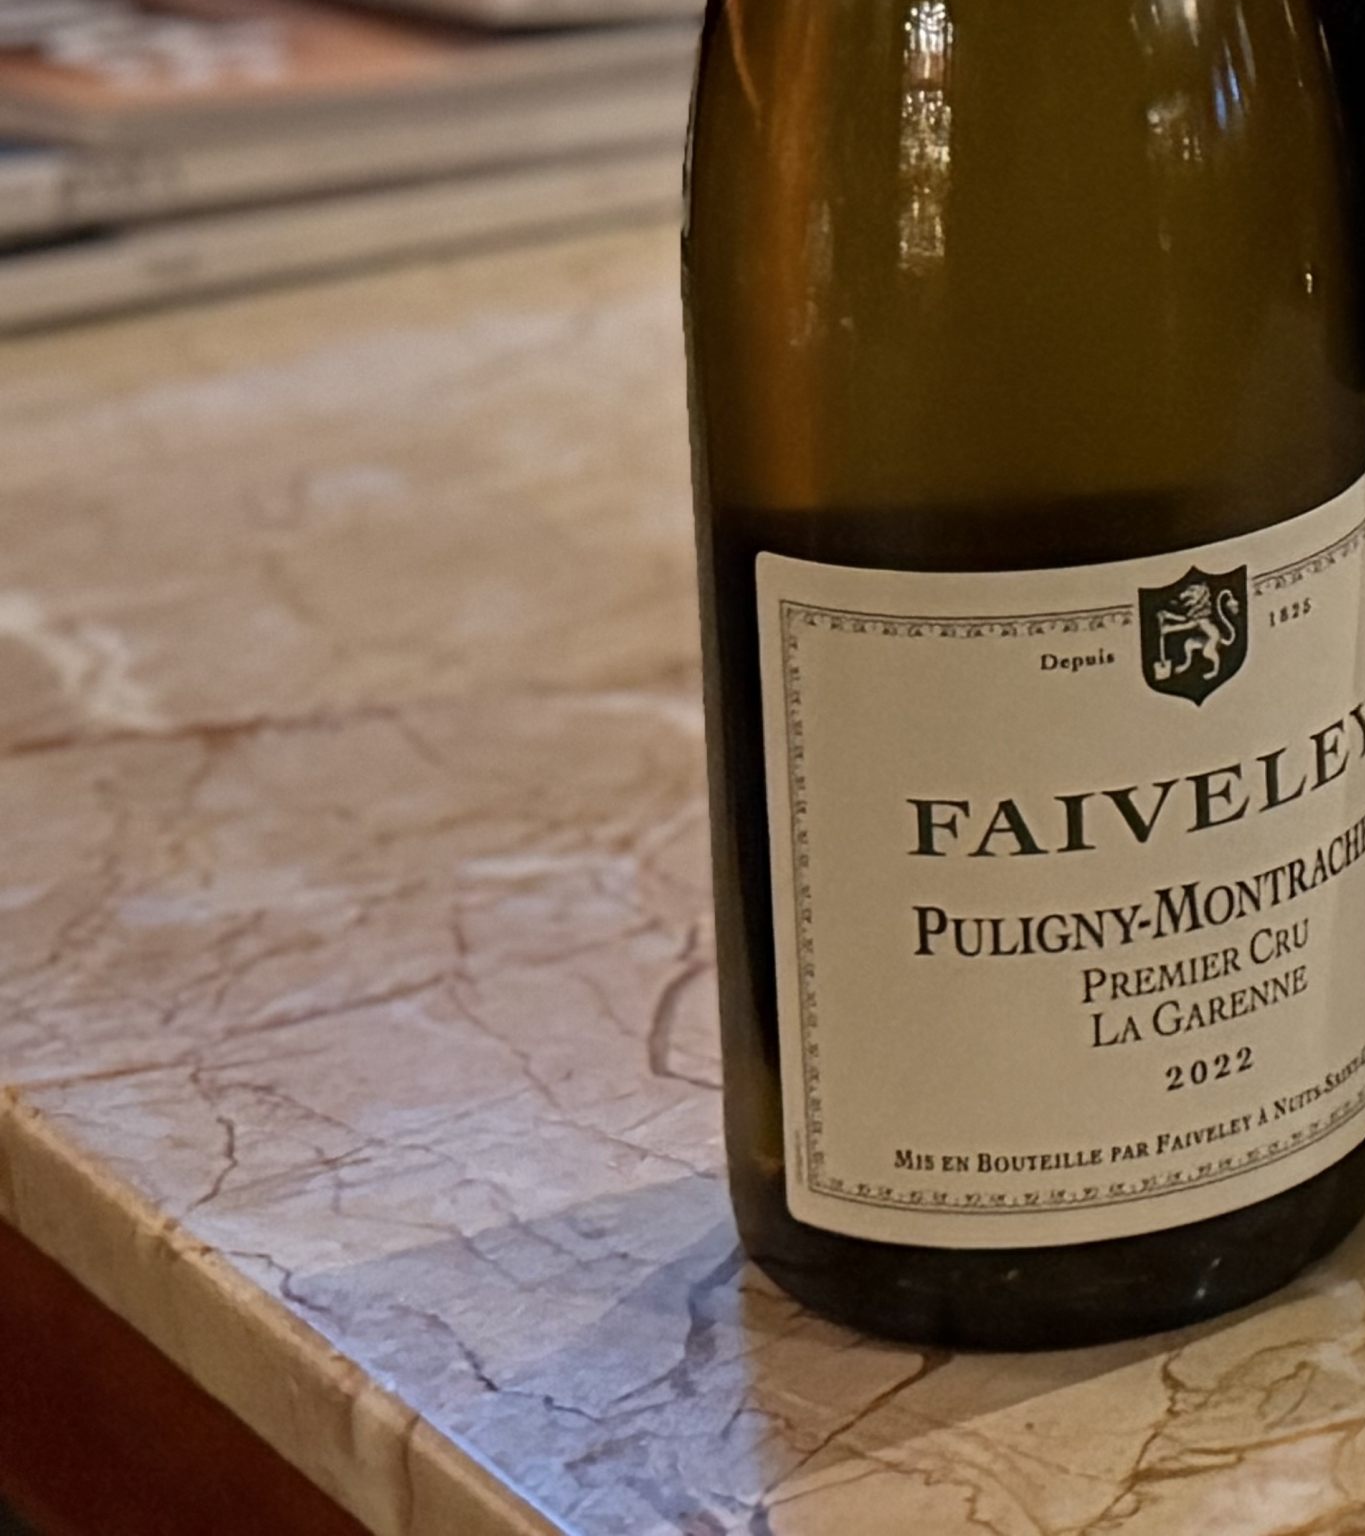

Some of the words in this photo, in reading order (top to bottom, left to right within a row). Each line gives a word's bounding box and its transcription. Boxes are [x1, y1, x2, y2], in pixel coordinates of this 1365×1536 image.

[1040, 648, 1115, 672] Depuis
[1269, 597, 1313, 628] 1825
[1081, 948, 1242, 1005] PREMIER
[1248, 917, 1311, 967] CRU
[1090, 1011, 1144, 1051] LA
[1151, 963, 1309, 1038] GARENNE
[1164, 1045, 1255, 1094] 2022
[894, 1148, 935, 1172] MIS
[941, 1153, 970, 1173] EN
[976, 1148, 1104, 1175] BOUTEILLE
[1110, 1141, 1149, 1164] PAR
[1155, 1114, 1253, 1156] FAIVELEY
